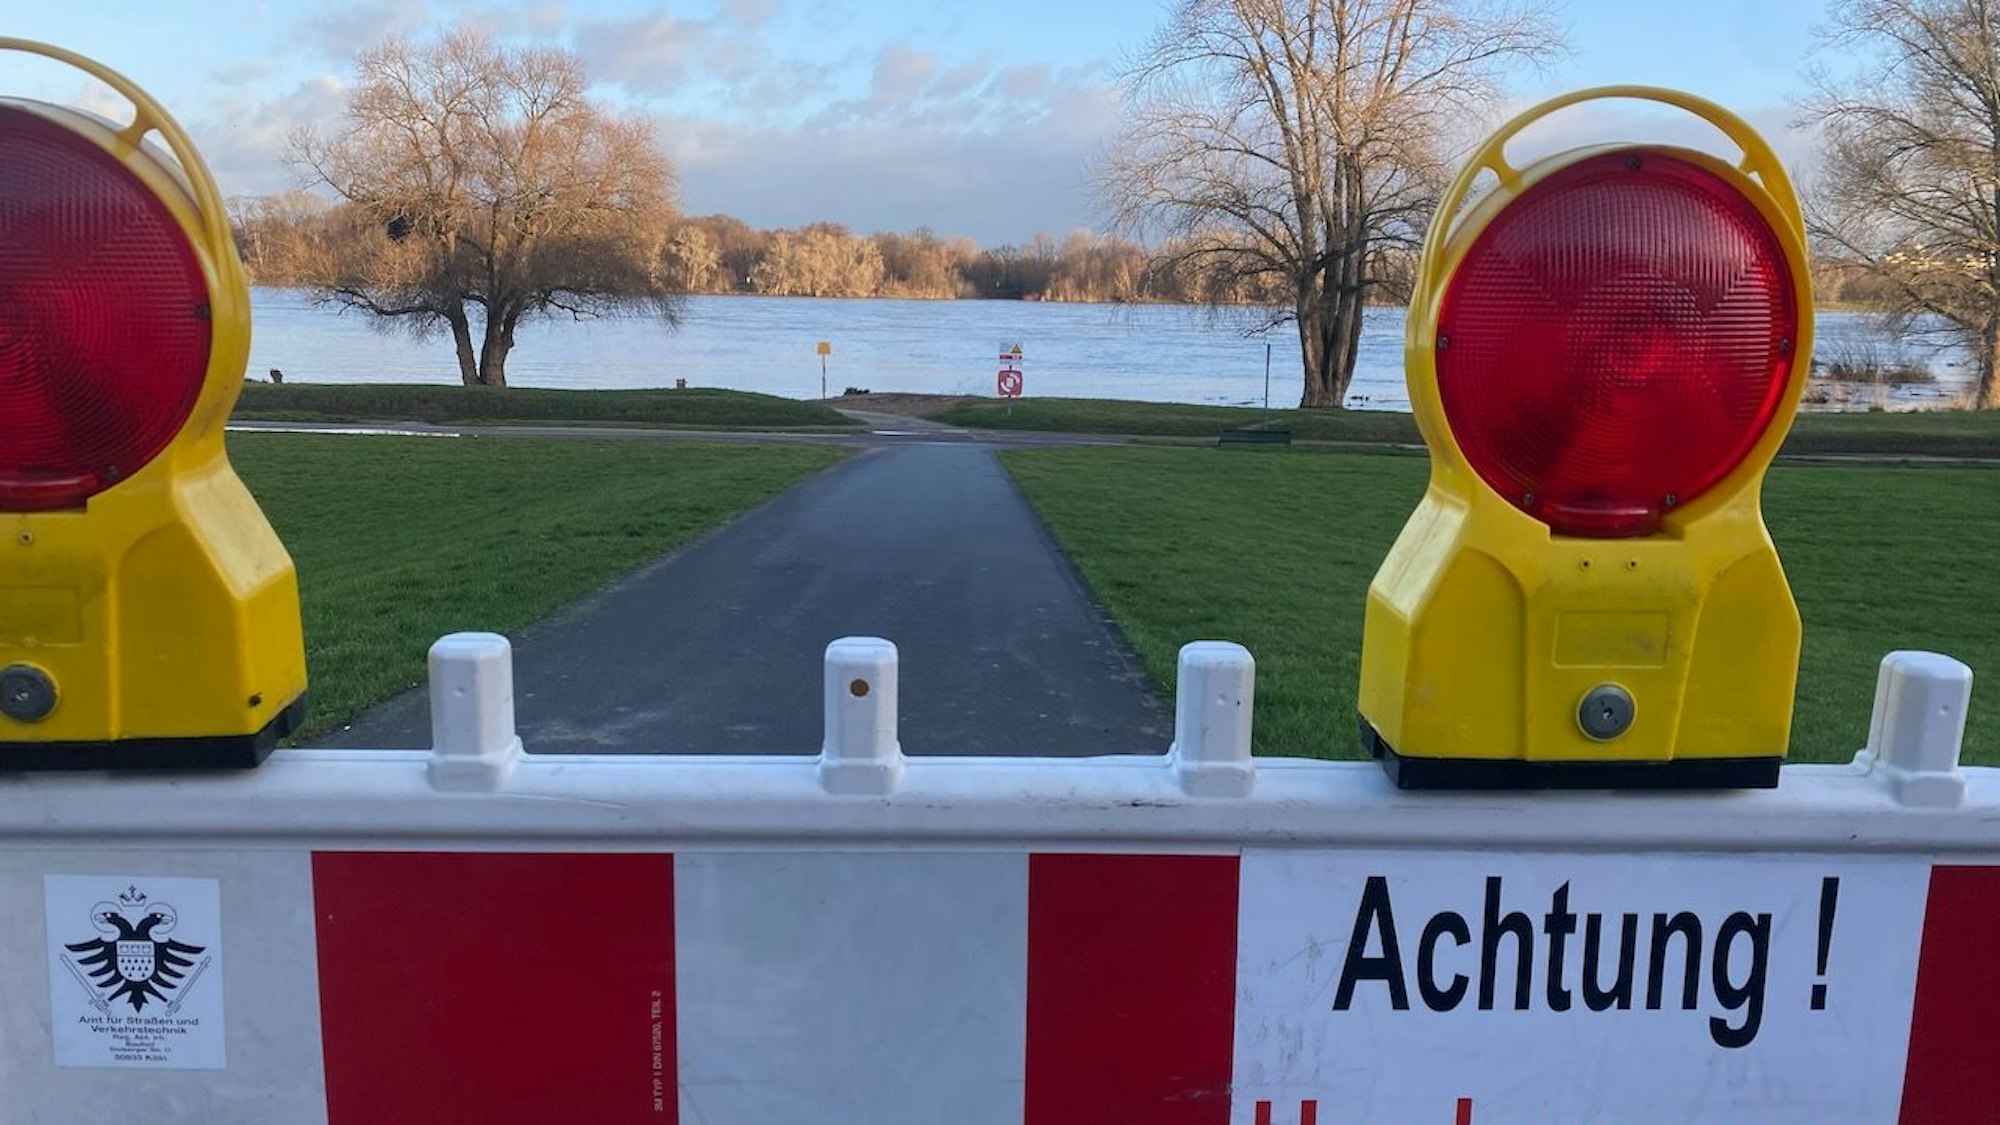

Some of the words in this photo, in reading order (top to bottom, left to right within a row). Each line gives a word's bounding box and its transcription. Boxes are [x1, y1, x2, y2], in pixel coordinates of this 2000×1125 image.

[1332, 876, 1772, 1049] Achtung
[1809, 876, 1840, 1011] !
[651, 998, 662, 1020] TEIL
[79, 1015, 103, 1024] Amt
[106, 1015, 123, 1025] für
[126, 1016, 173, 1026] Straßen
[176, 1017, 200, 1027] und
[90, 1025, 188, 1035] Verkehrstechnik
[652, 1052, 663, 1071] DIN
[653, 1078, 663, 1097] TYP
